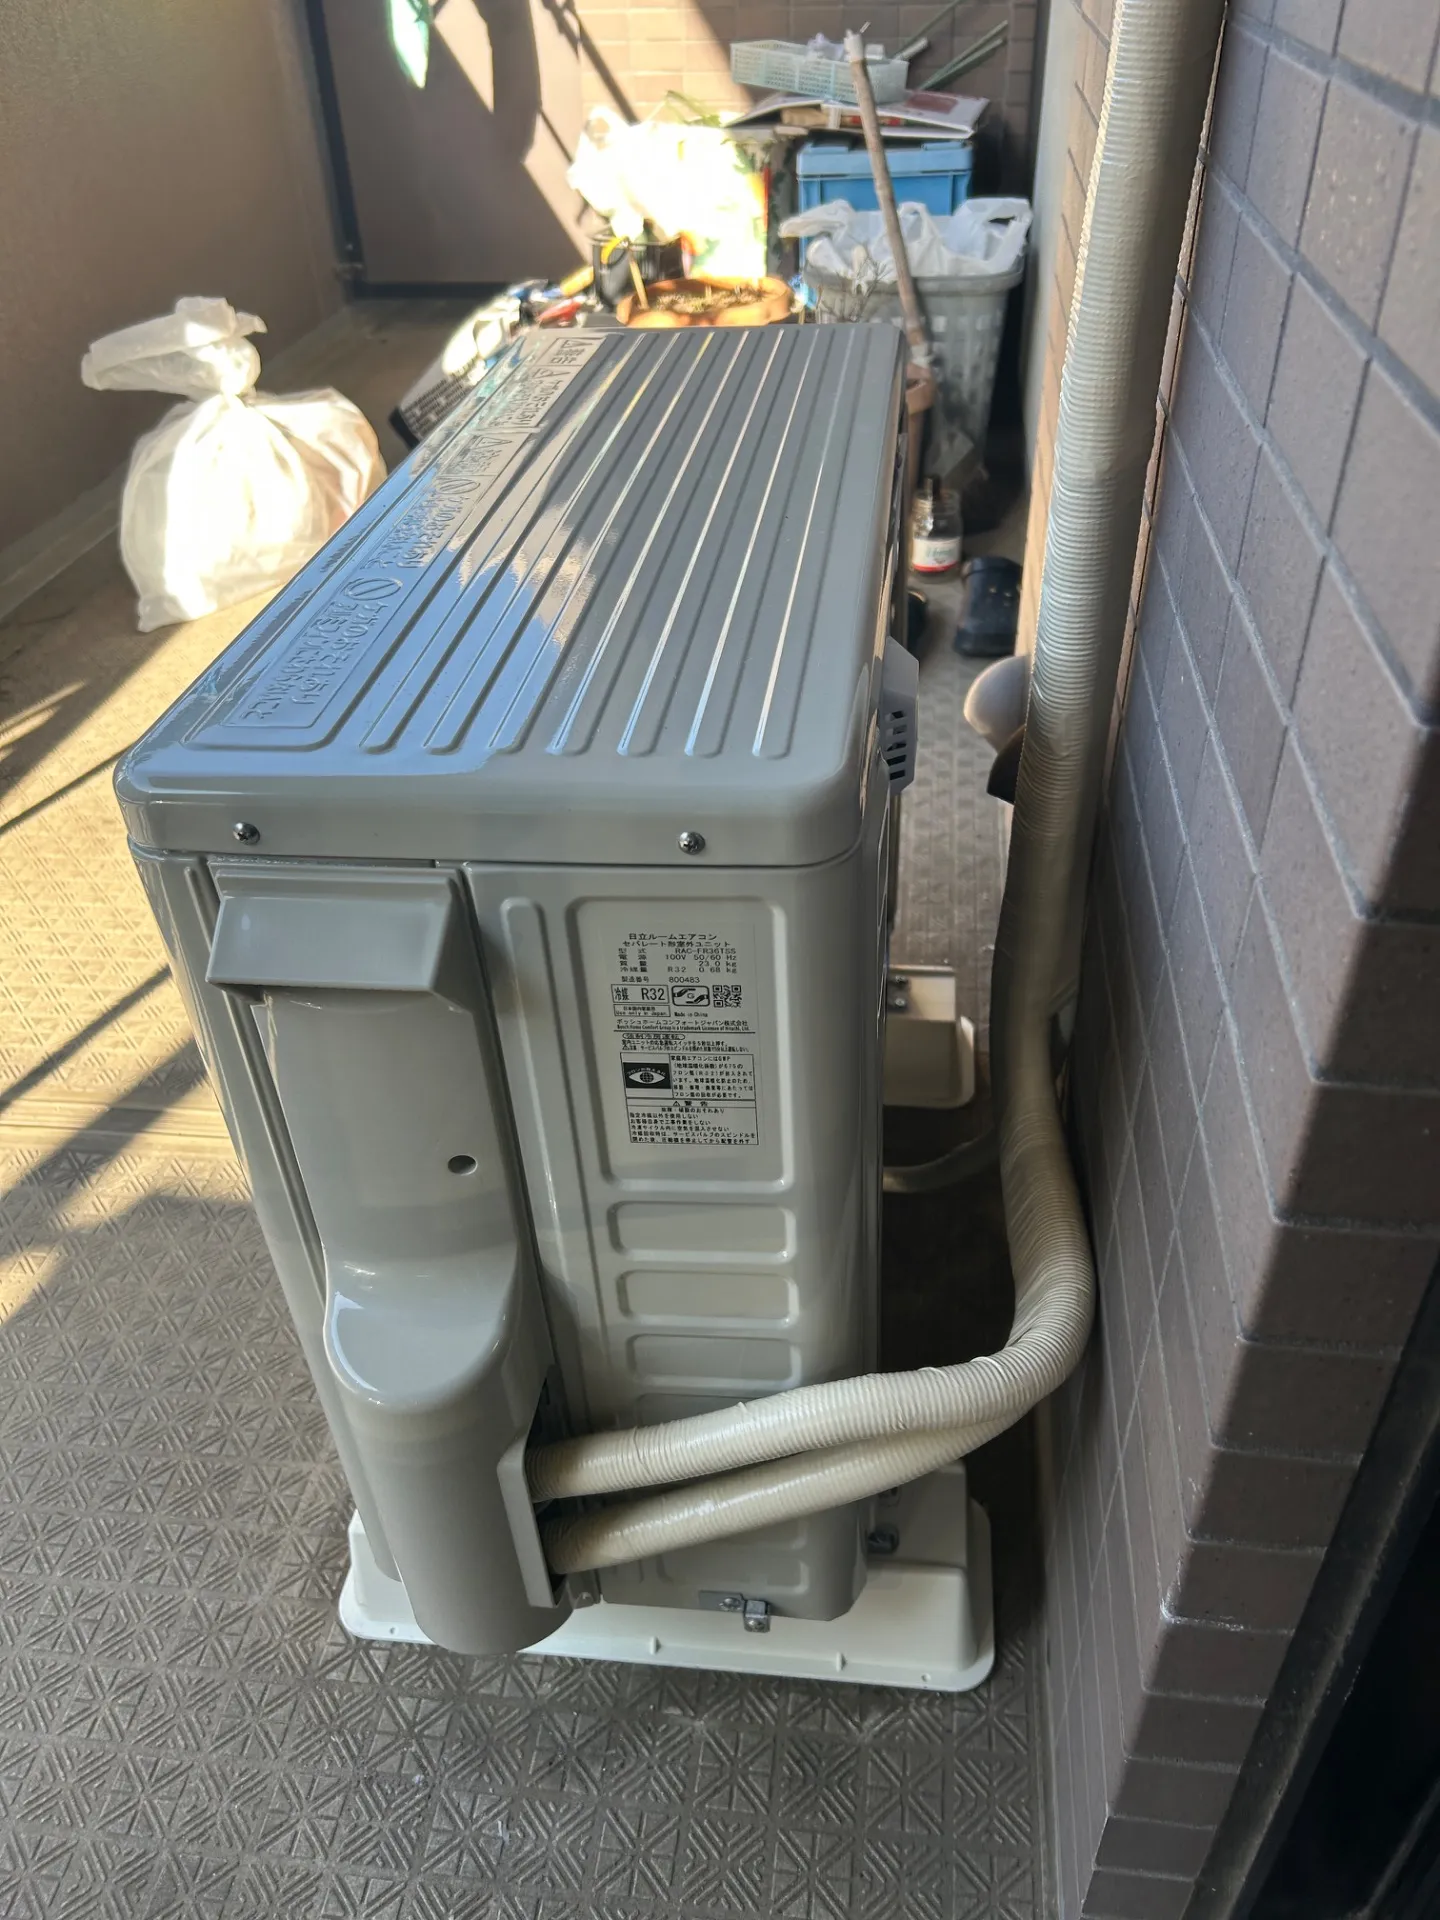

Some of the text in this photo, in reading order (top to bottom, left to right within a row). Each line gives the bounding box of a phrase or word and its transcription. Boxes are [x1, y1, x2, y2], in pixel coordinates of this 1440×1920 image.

[289, 601, 390, 705] ケガのおそれあり
[641, 988, 666, 1001] R32
